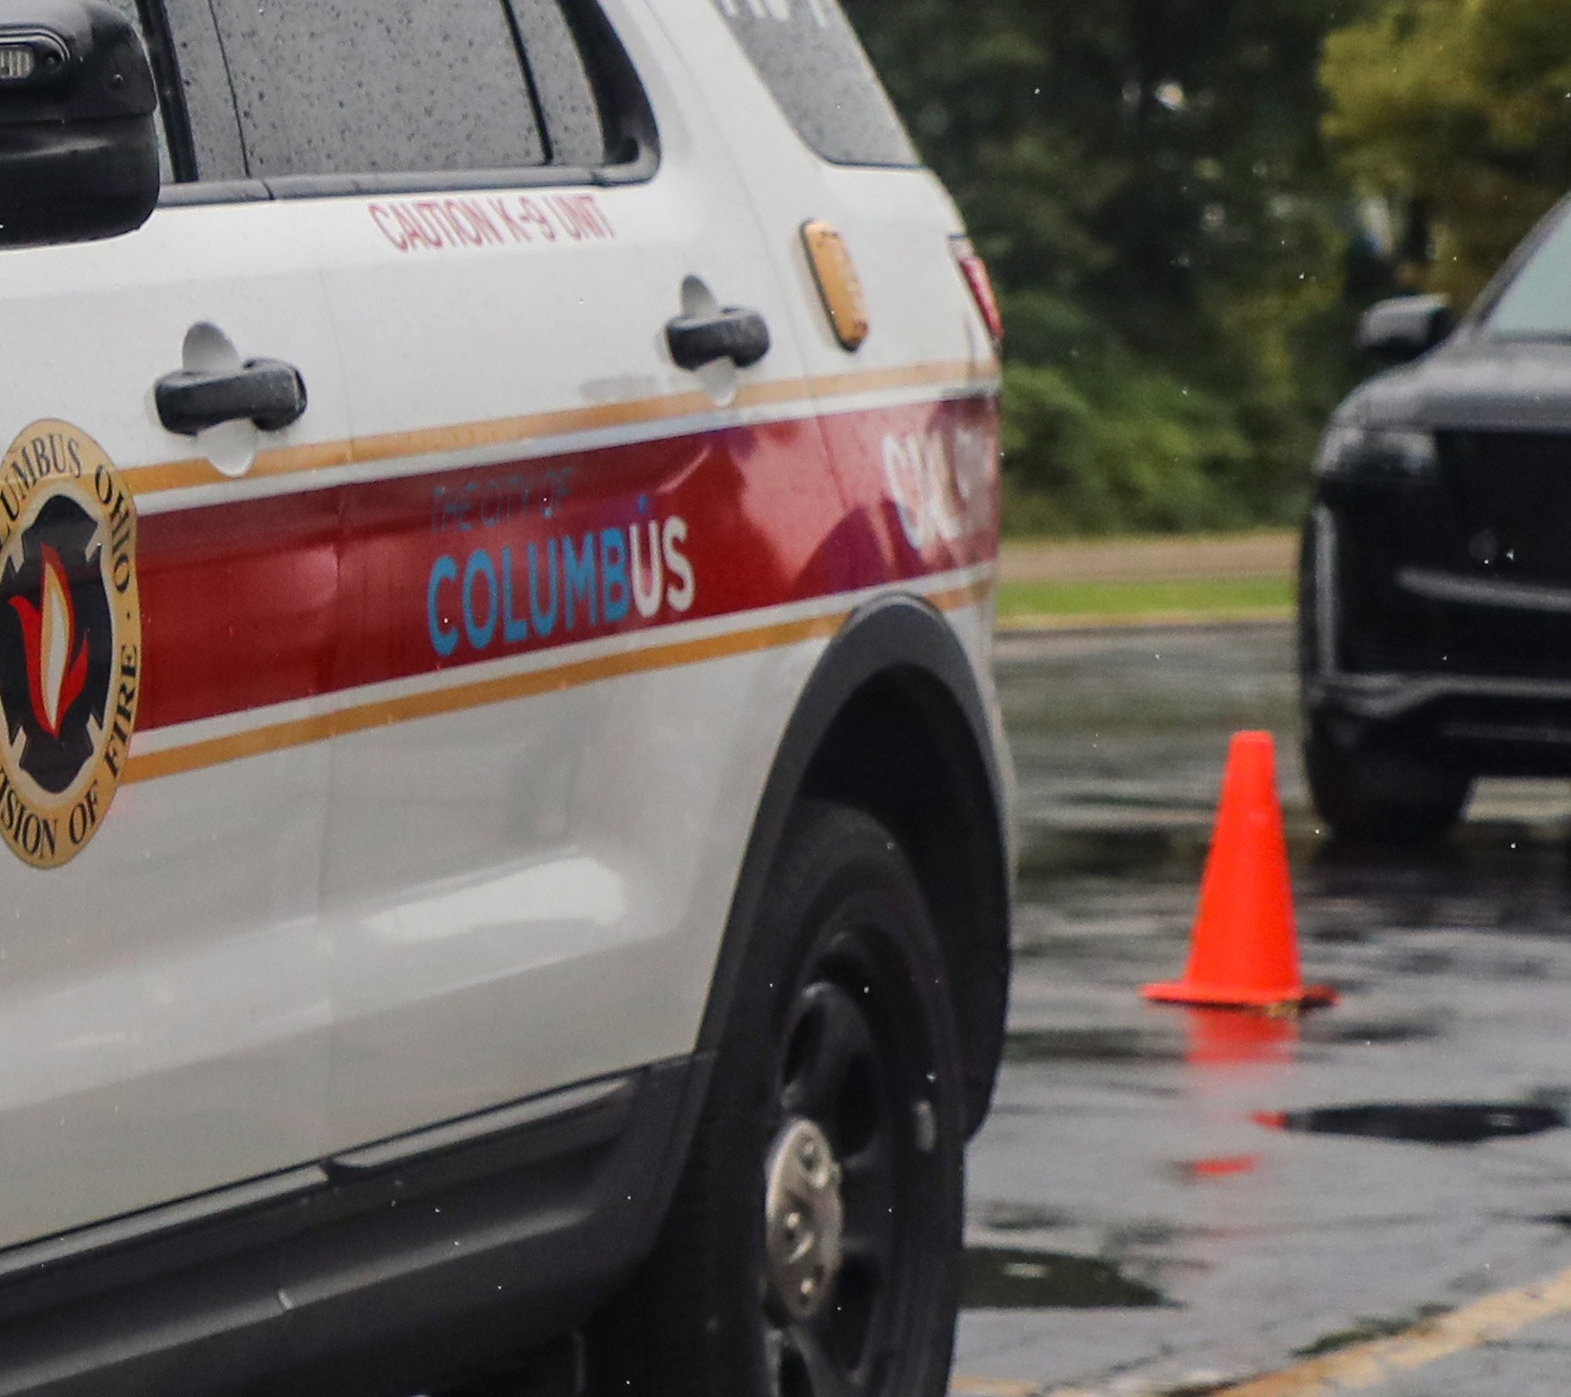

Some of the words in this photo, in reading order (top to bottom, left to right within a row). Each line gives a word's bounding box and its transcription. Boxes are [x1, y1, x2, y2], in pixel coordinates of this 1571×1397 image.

[368, 198, 504, 253] CAUTION
[486, 196, 556, 243] K-9
[541, 193, 616, 242] UNIT
[94, 465, 131, 594] OHIO
[427, 515, 696, 657] COLUMBUS
[68, 789, 101, 845] OF
[103, 644, 138, 774] FIRE
